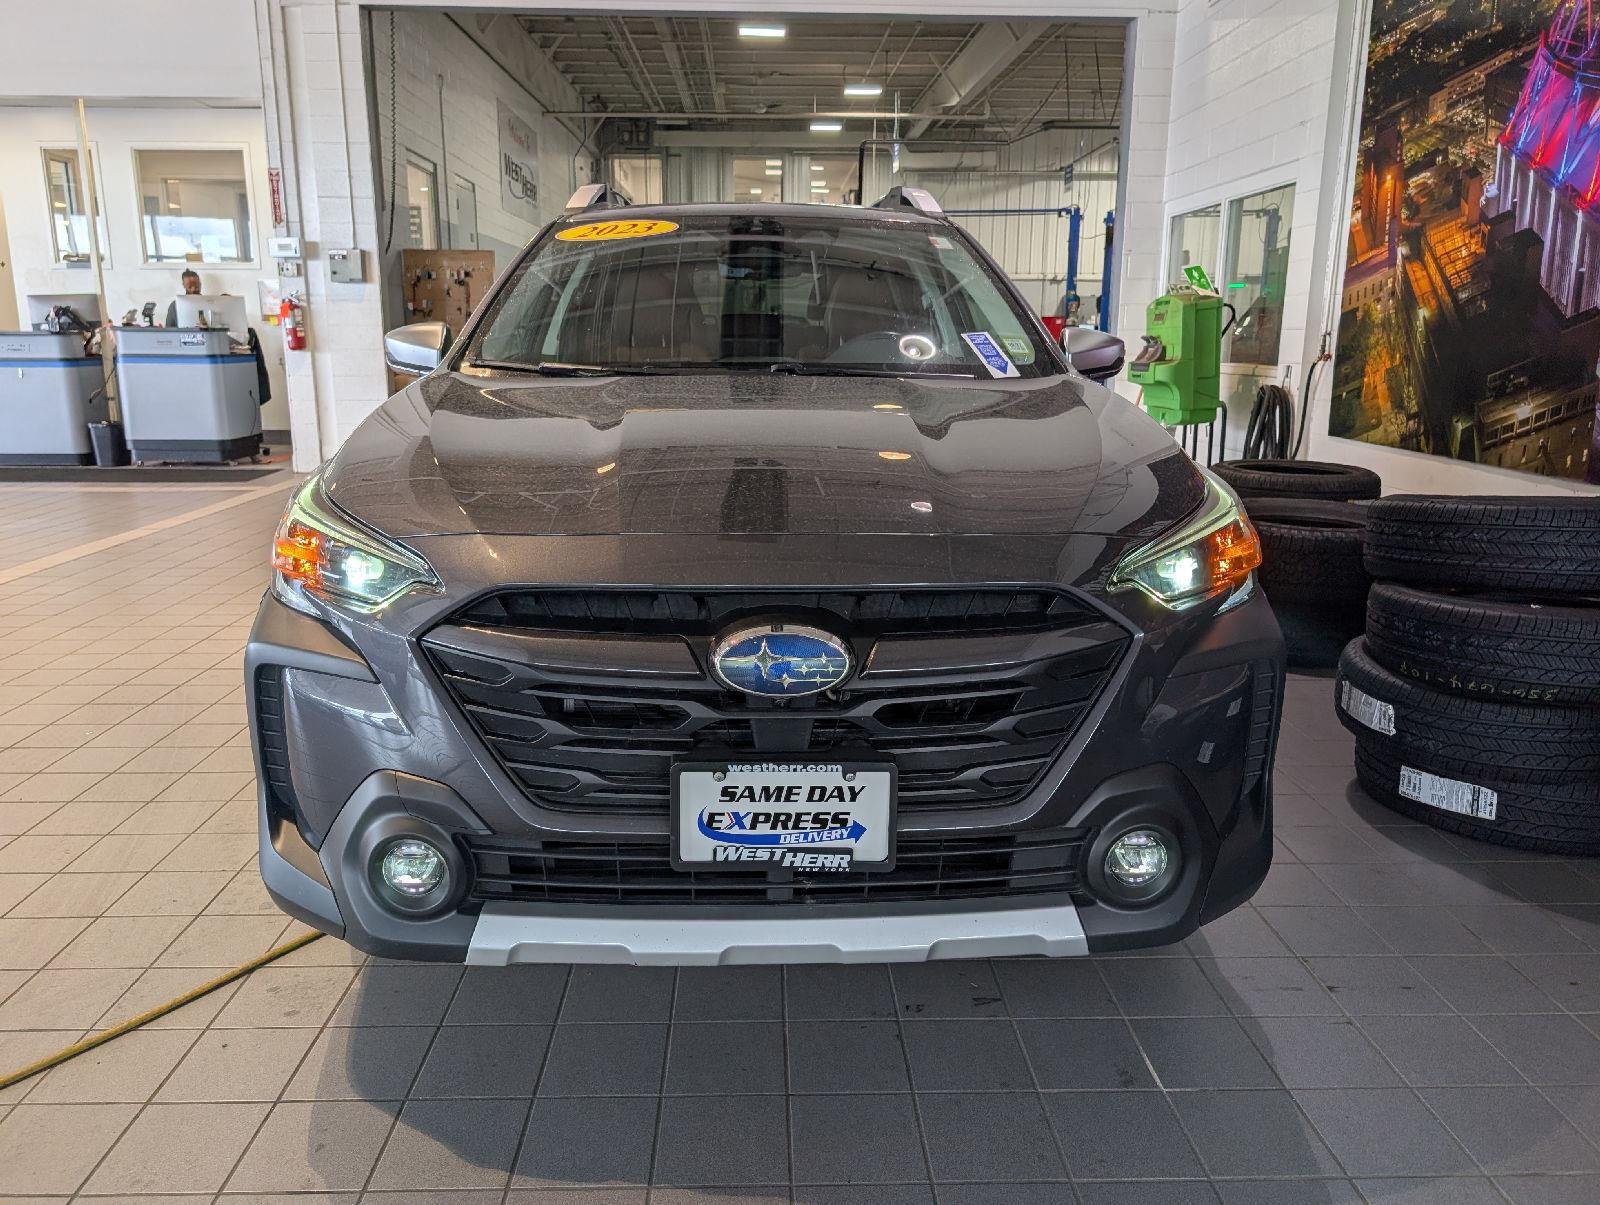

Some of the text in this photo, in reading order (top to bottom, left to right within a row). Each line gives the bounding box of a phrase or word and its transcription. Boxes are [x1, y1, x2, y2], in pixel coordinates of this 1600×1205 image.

[504, 152, 522, 184] WEST
[573, 222, 658, 239] 2023
[727, 763, 843, 773] westherr.com
[718, 785, 867, 803] SAME DAY
[705, 811, 851, 831] EXPRESS
[779, 827, 851, 845] DELIVERY
